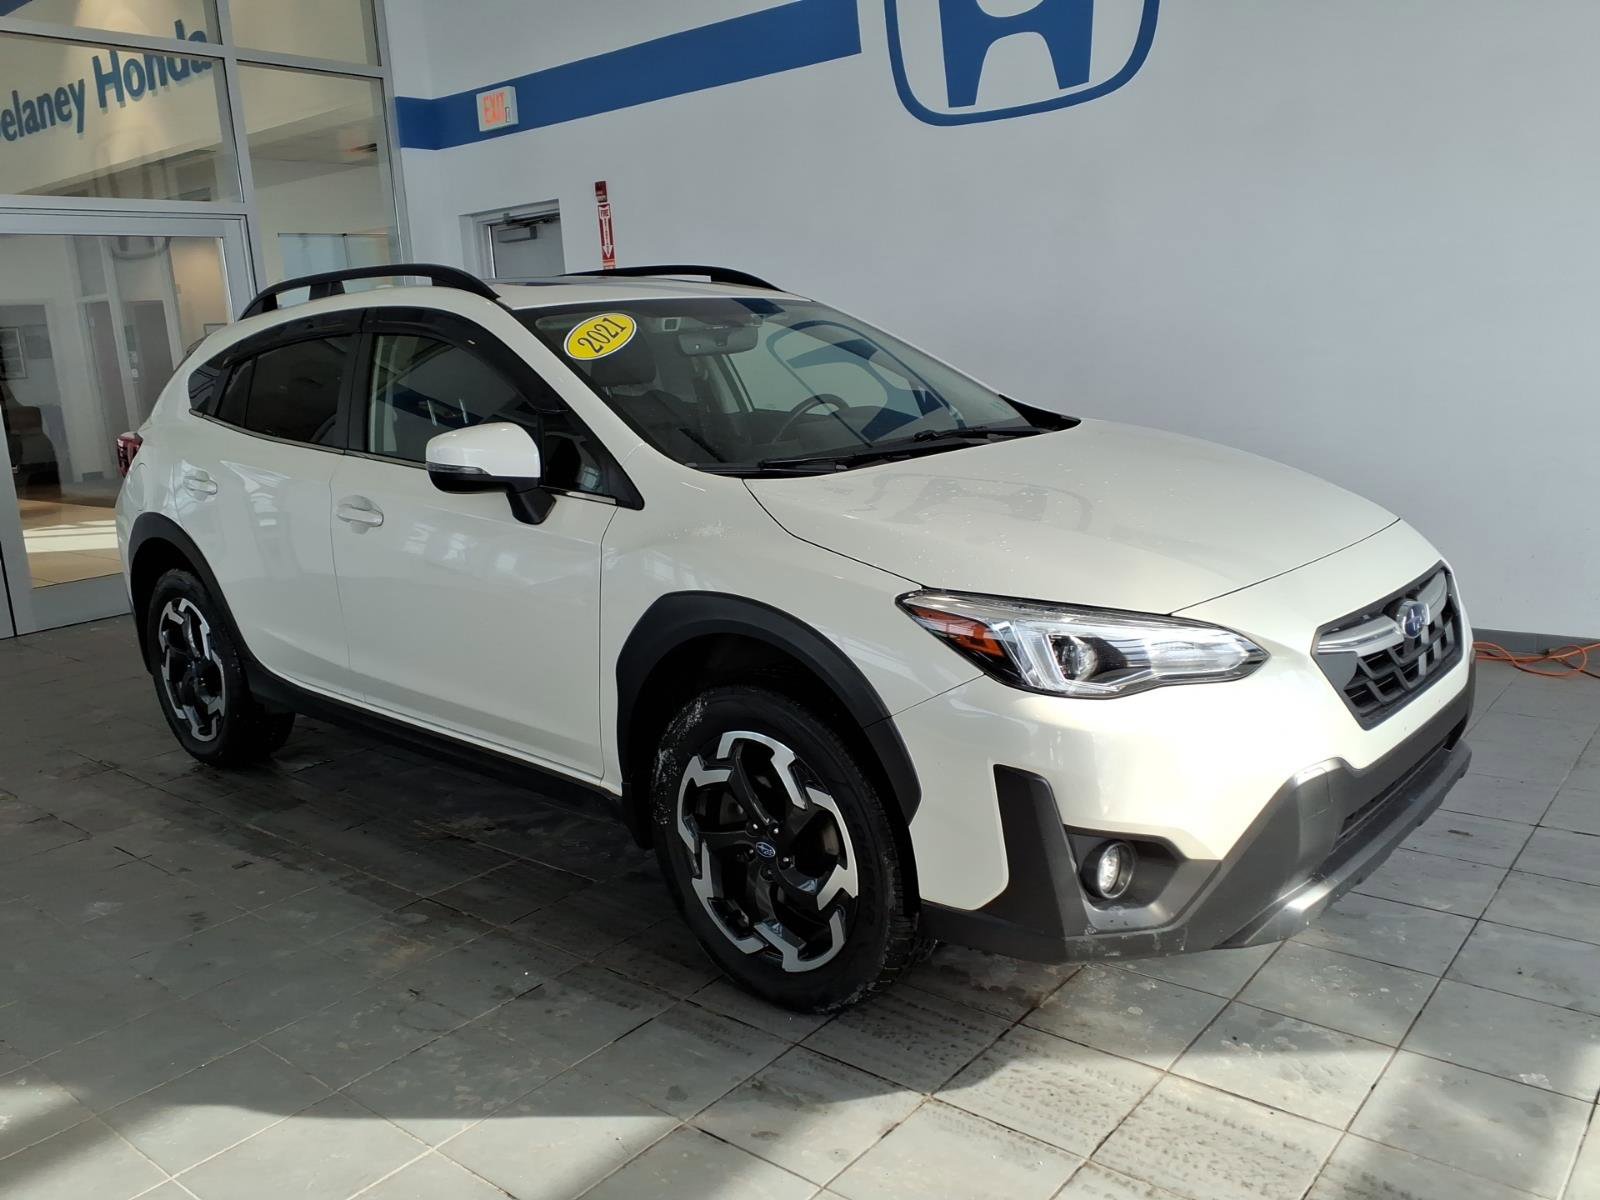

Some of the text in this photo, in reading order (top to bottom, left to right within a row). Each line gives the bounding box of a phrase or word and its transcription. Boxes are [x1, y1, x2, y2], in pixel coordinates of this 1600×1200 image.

[0, 19, 212, 141] elaney Honda
[483, 92, 506, 126] EXIT
[577, 317, 627, 354] 2021
